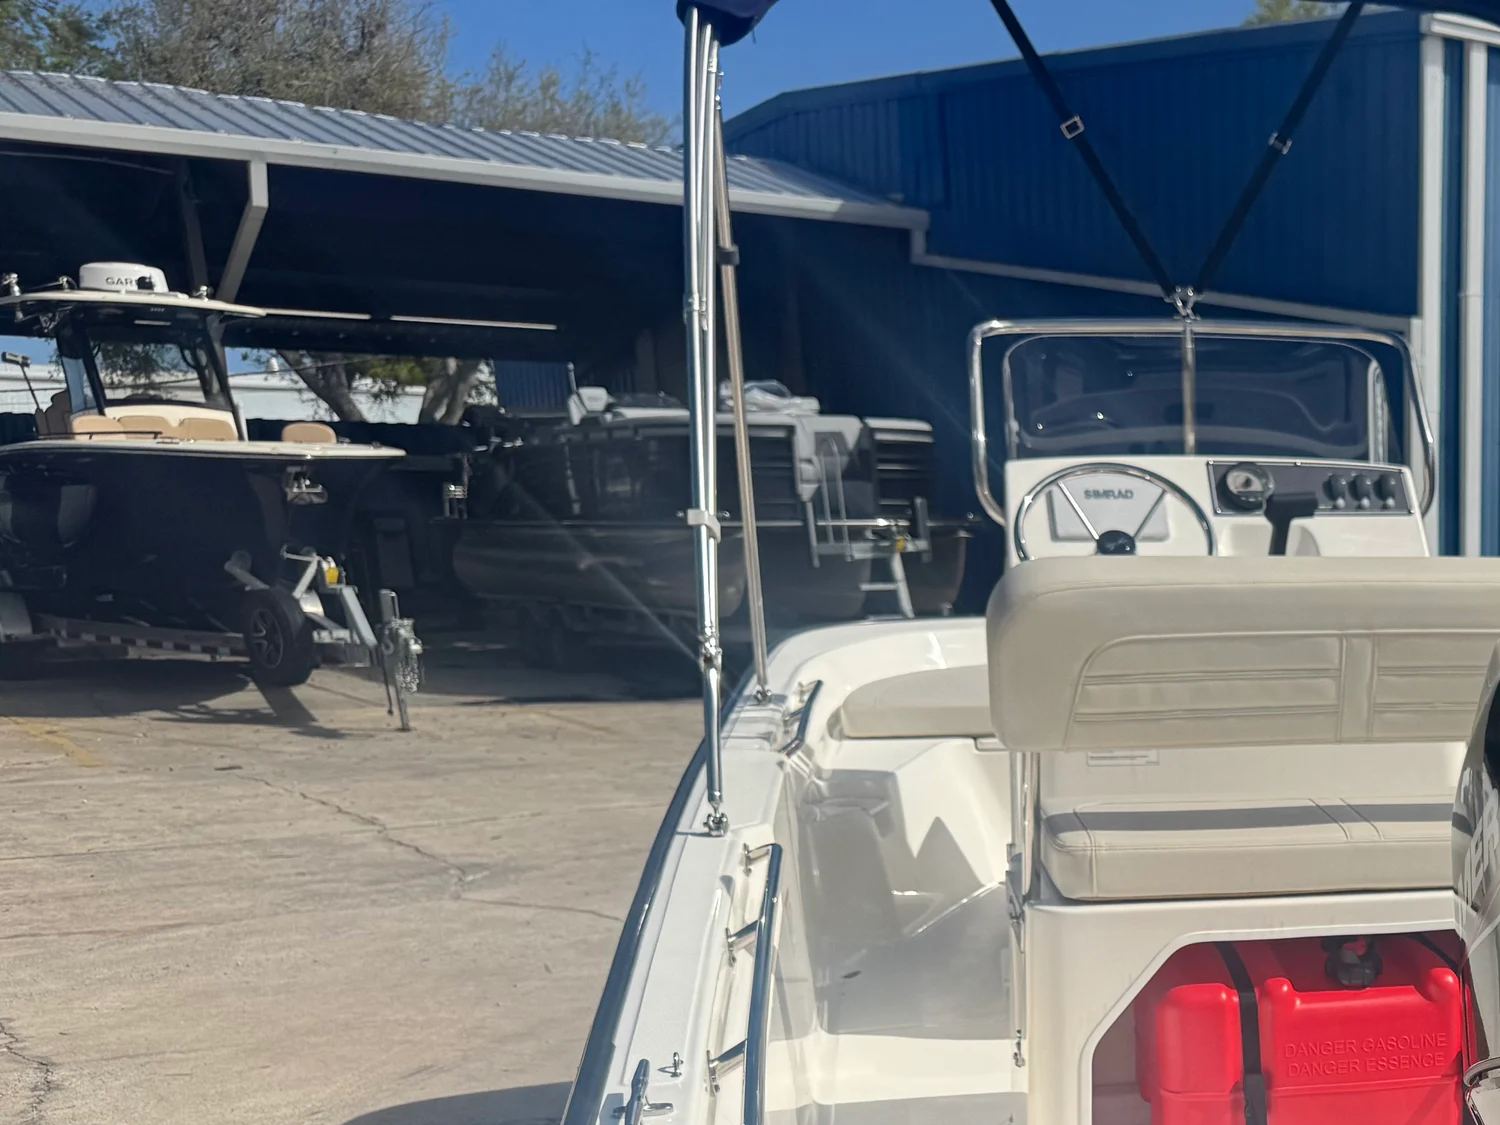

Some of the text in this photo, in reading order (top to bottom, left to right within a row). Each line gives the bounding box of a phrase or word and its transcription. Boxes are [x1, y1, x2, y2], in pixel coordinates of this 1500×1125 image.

[1084, 489, 1134, 500] SIMRAD
[1285, 1032, 1448, 1058] DANGER GASOLINE
[1288, 1052, 1446, 1078] DANGER ESSENCE
